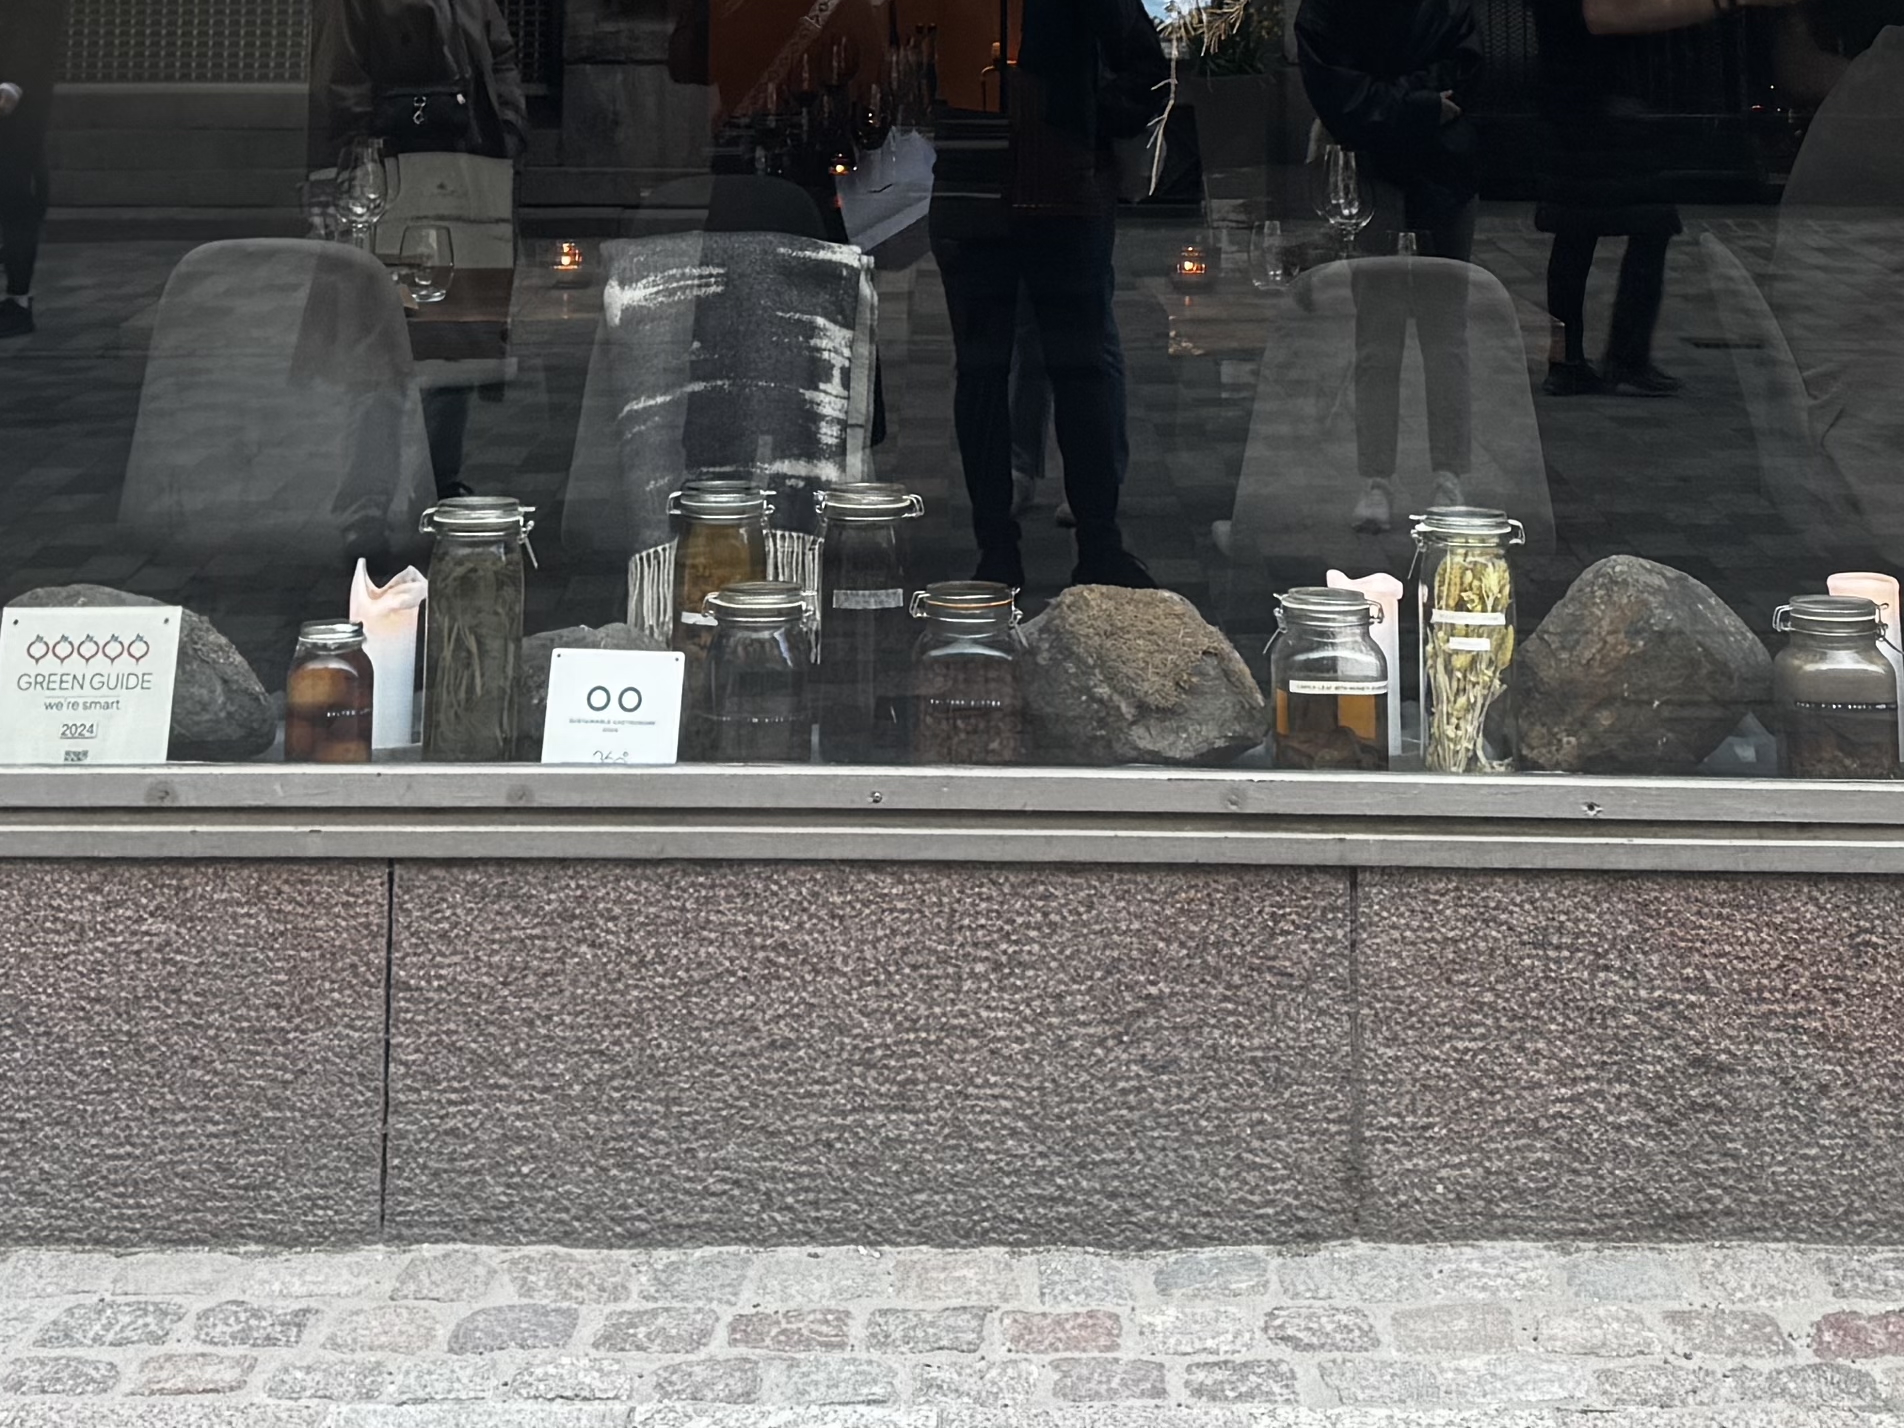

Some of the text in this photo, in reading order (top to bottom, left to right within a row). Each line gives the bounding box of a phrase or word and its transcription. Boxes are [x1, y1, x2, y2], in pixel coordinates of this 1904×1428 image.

[16, 672, 154, 691] GREEN GUIDE
[43, 696, 121, 711] we're smart
[59, 723, 96, 737] 2024
